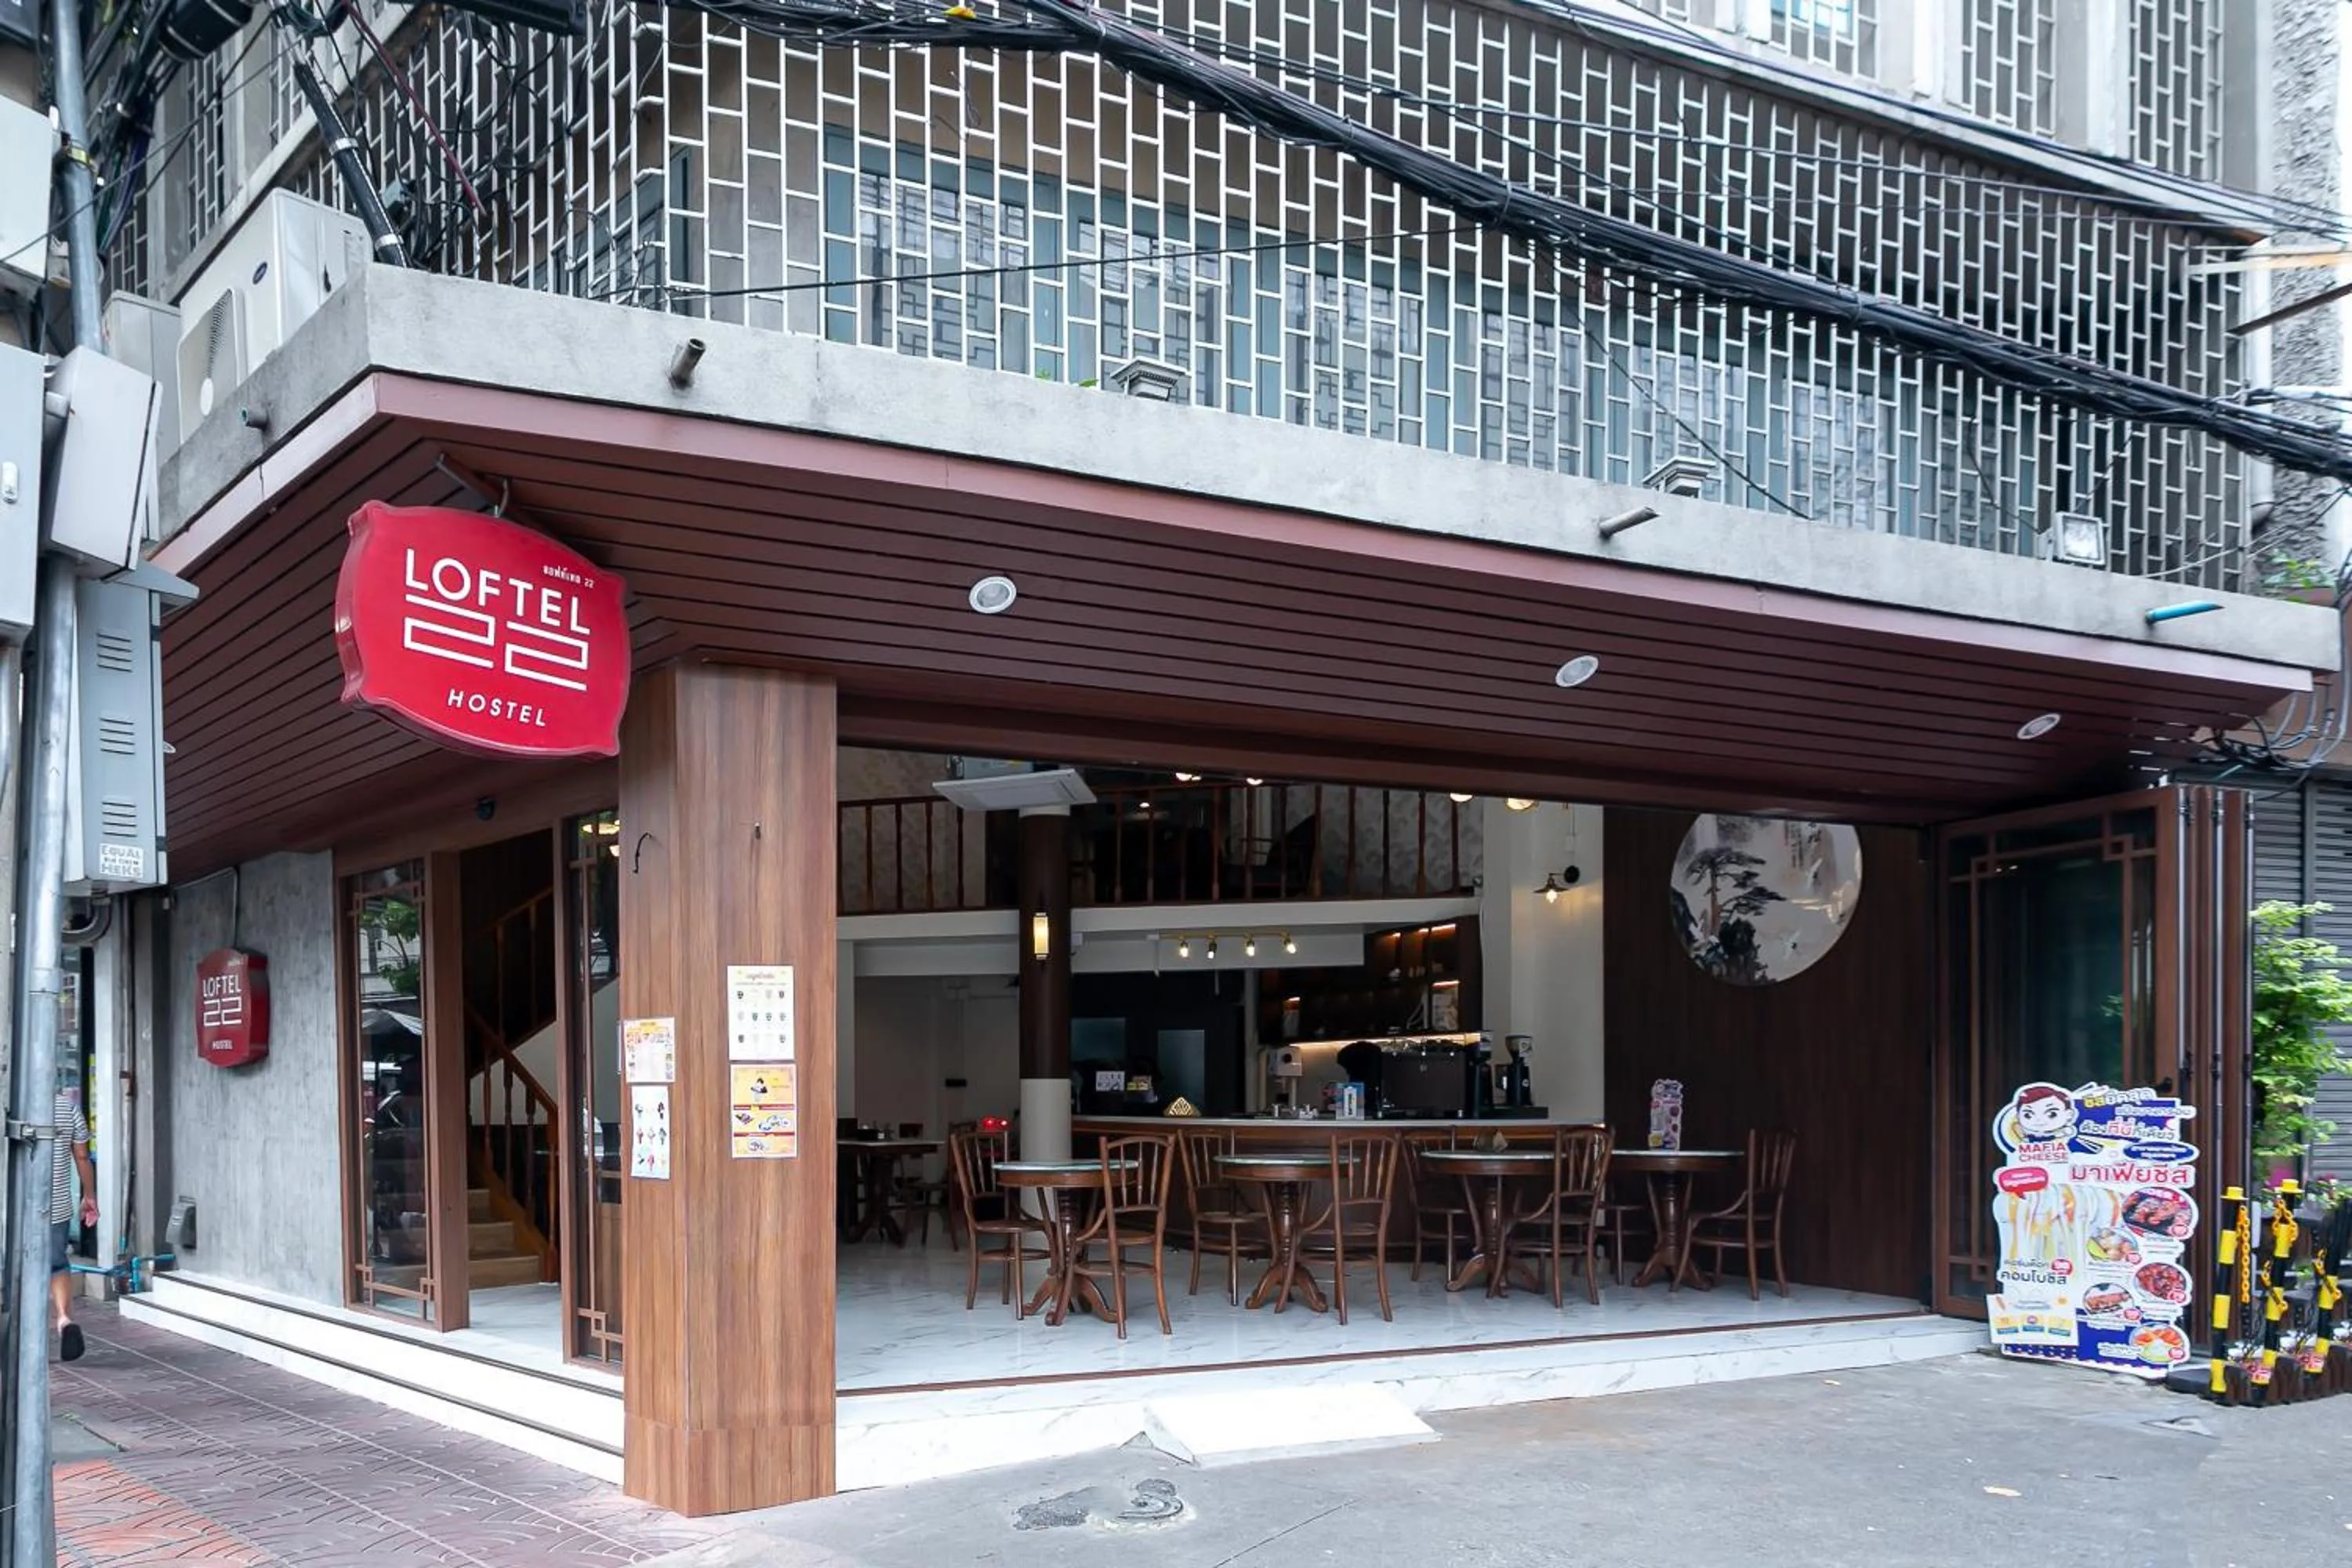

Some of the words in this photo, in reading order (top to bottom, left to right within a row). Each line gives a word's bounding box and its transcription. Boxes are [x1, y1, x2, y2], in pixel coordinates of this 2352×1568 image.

[405, 548, 590, 635] LOFTEL
[404, 593, 590, 691] 22
[447, 688, 546, 727] HOSTEL
[202, 975, 242, 997] LOFTEL
[203, 996, 242, 1026] 22
[212, 1039, 234, 1050] HOSTEL
[2019, 1142, 2067, 1153] MAFIA
[2019, 1152, 2068, 1163] CHEESE
[2071, 1163, 2187, 1184] มาเฟียชีส
